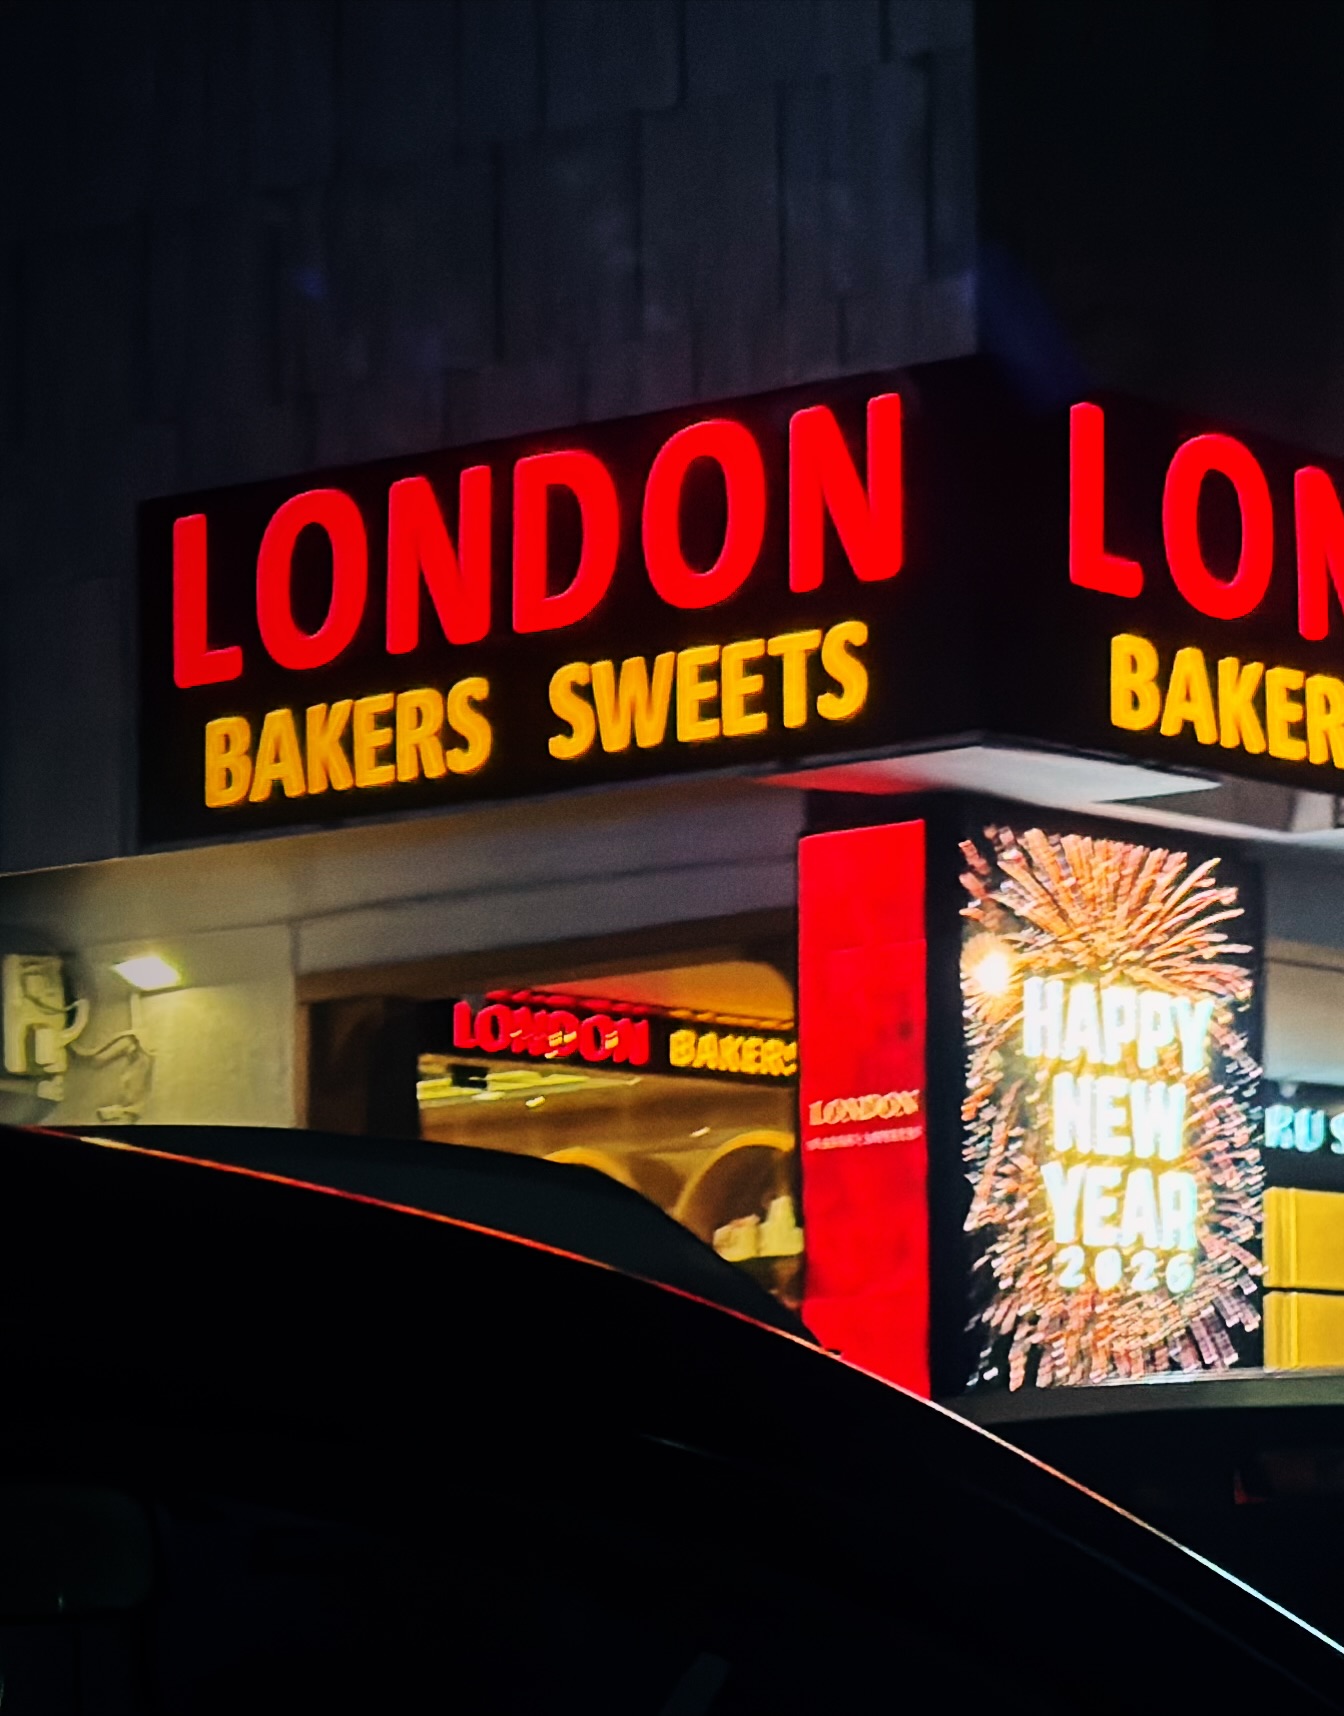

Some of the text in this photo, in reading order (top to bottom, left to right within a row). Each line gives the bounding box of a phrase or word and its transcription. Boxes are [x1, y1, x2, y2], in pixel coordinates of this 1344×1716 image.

[173, 392, 906, 690] LONDON
[203, 620, 871, 809] BAKERS SWEETS
[452, 999, 650, 1067] LONDON
[1021, 976, 1214, 1075] HAPPY
[808, 1088, 920, 1127] LONDON
[1051, 1071, 1187, 1162] NEW
[1041, 1160, 1198, 1251] YEAR
[1057, 1246, 1196, 1295] 2026
